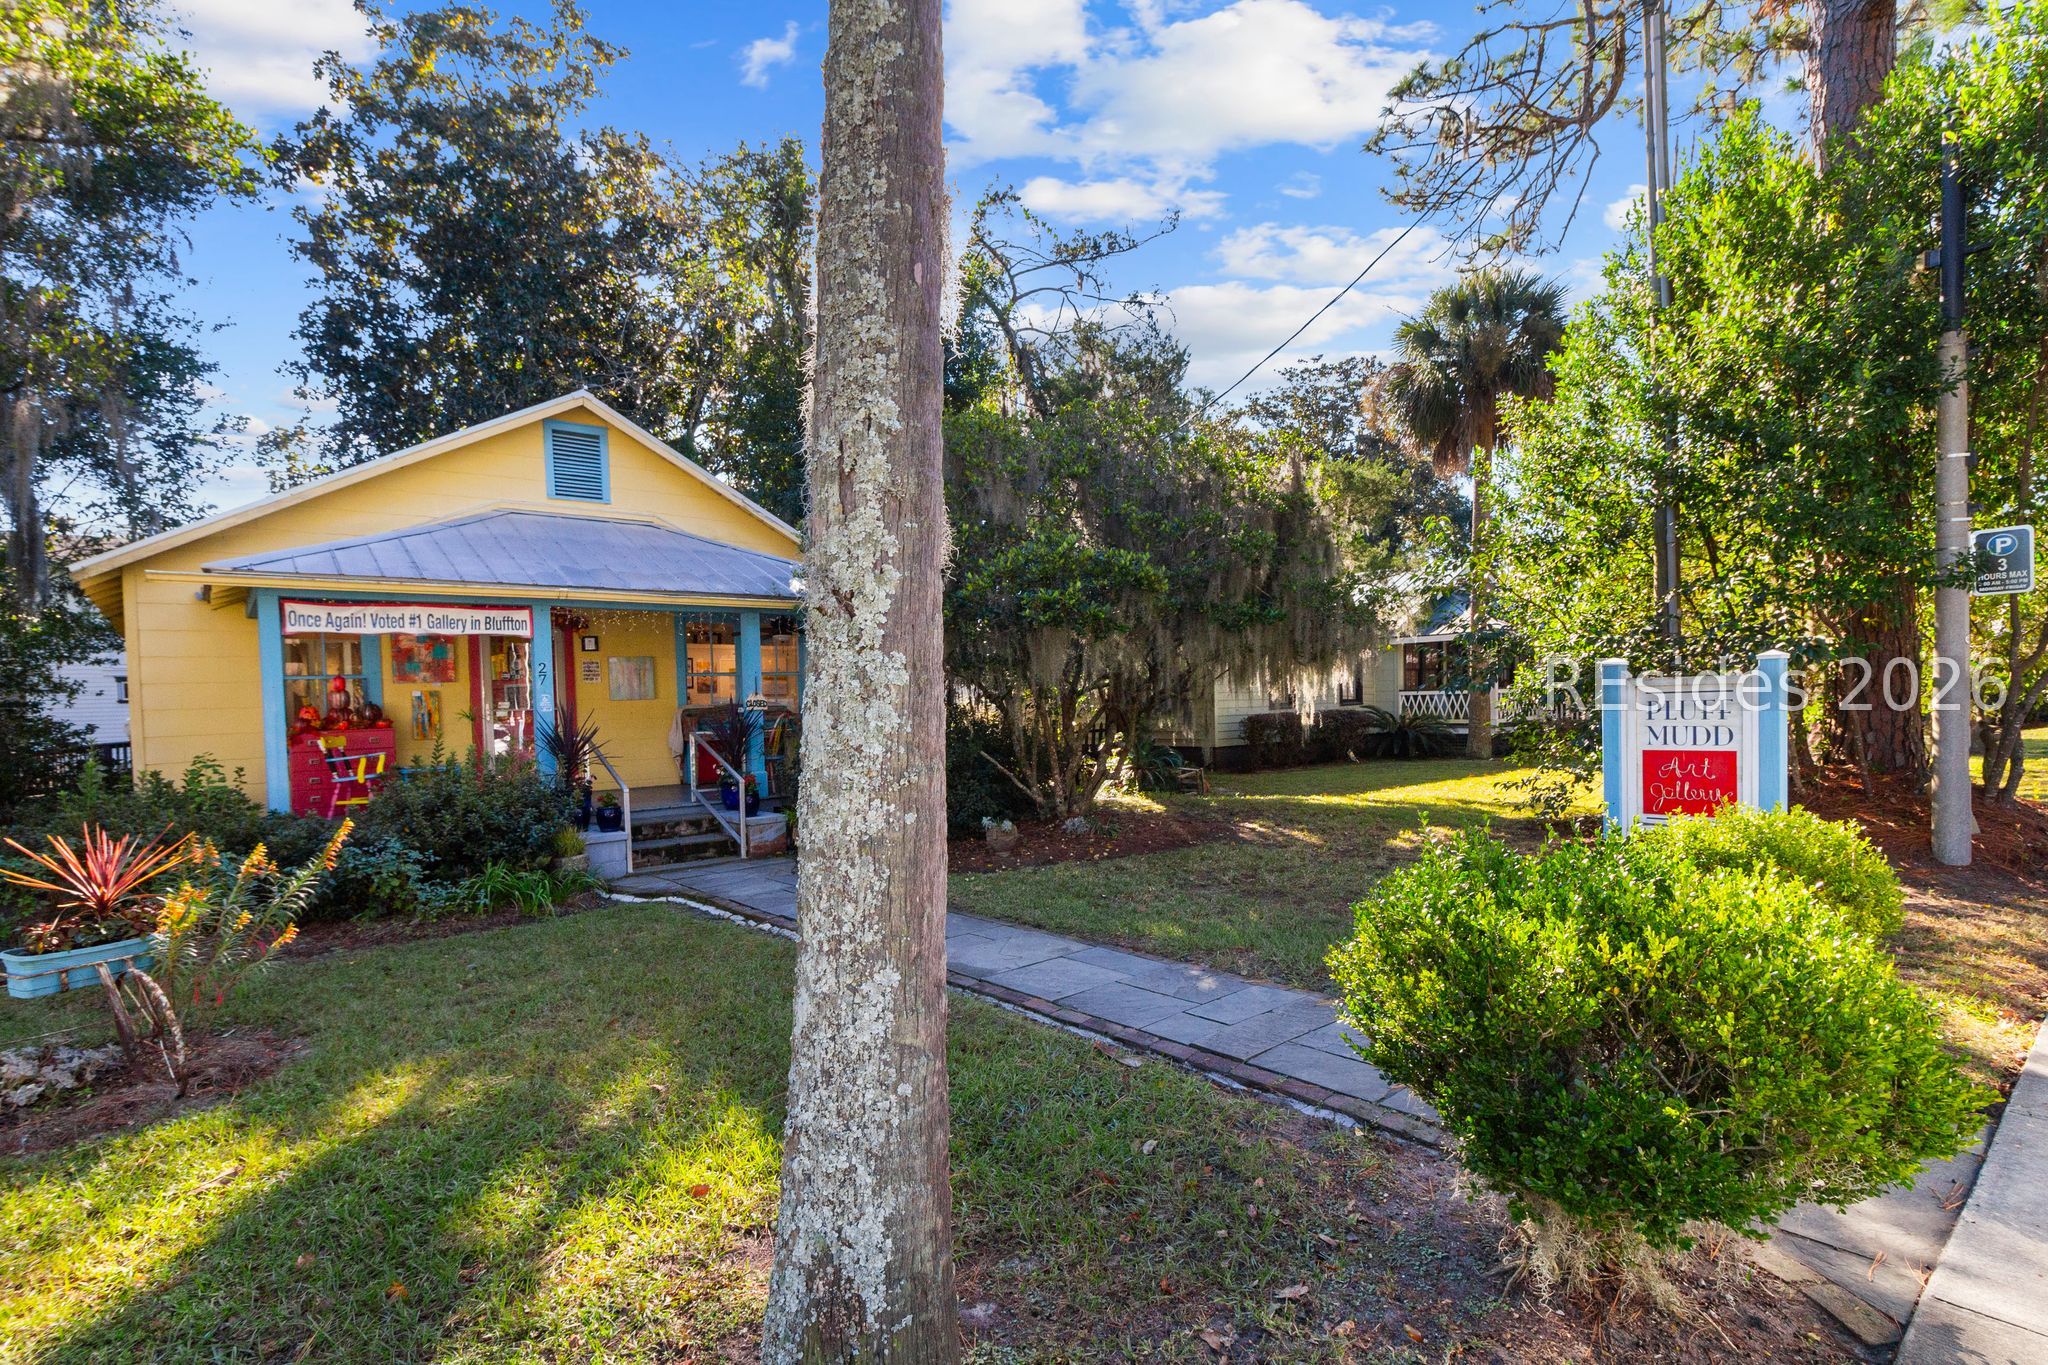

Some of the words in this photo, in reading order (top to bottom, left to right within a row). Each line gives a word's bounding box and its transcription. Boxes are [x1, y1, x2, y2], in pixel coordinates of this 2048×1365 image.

[1996, 538, 2012, 553] P
[1998, 558, 2008, 571] 3
[2009, 570, 2028, 578] MAX
[288, 610, 321, 627] Once
[325, 612, 366, 632] Again!
[370, 613, 405, 629] Voted
[409, 613, 422, 629] #1
[427, 613, 467, 633] Gallery
[471, 616, 480, 630] in
[484, 616, 528, 631] Bluffton
[746, 699, 768, 708] CLOSED
[1646, 699, 1733, 721] PLUFF
[1647, 725, 1734, 746] MUDD
[1658, 756, 1716, 780] Art
